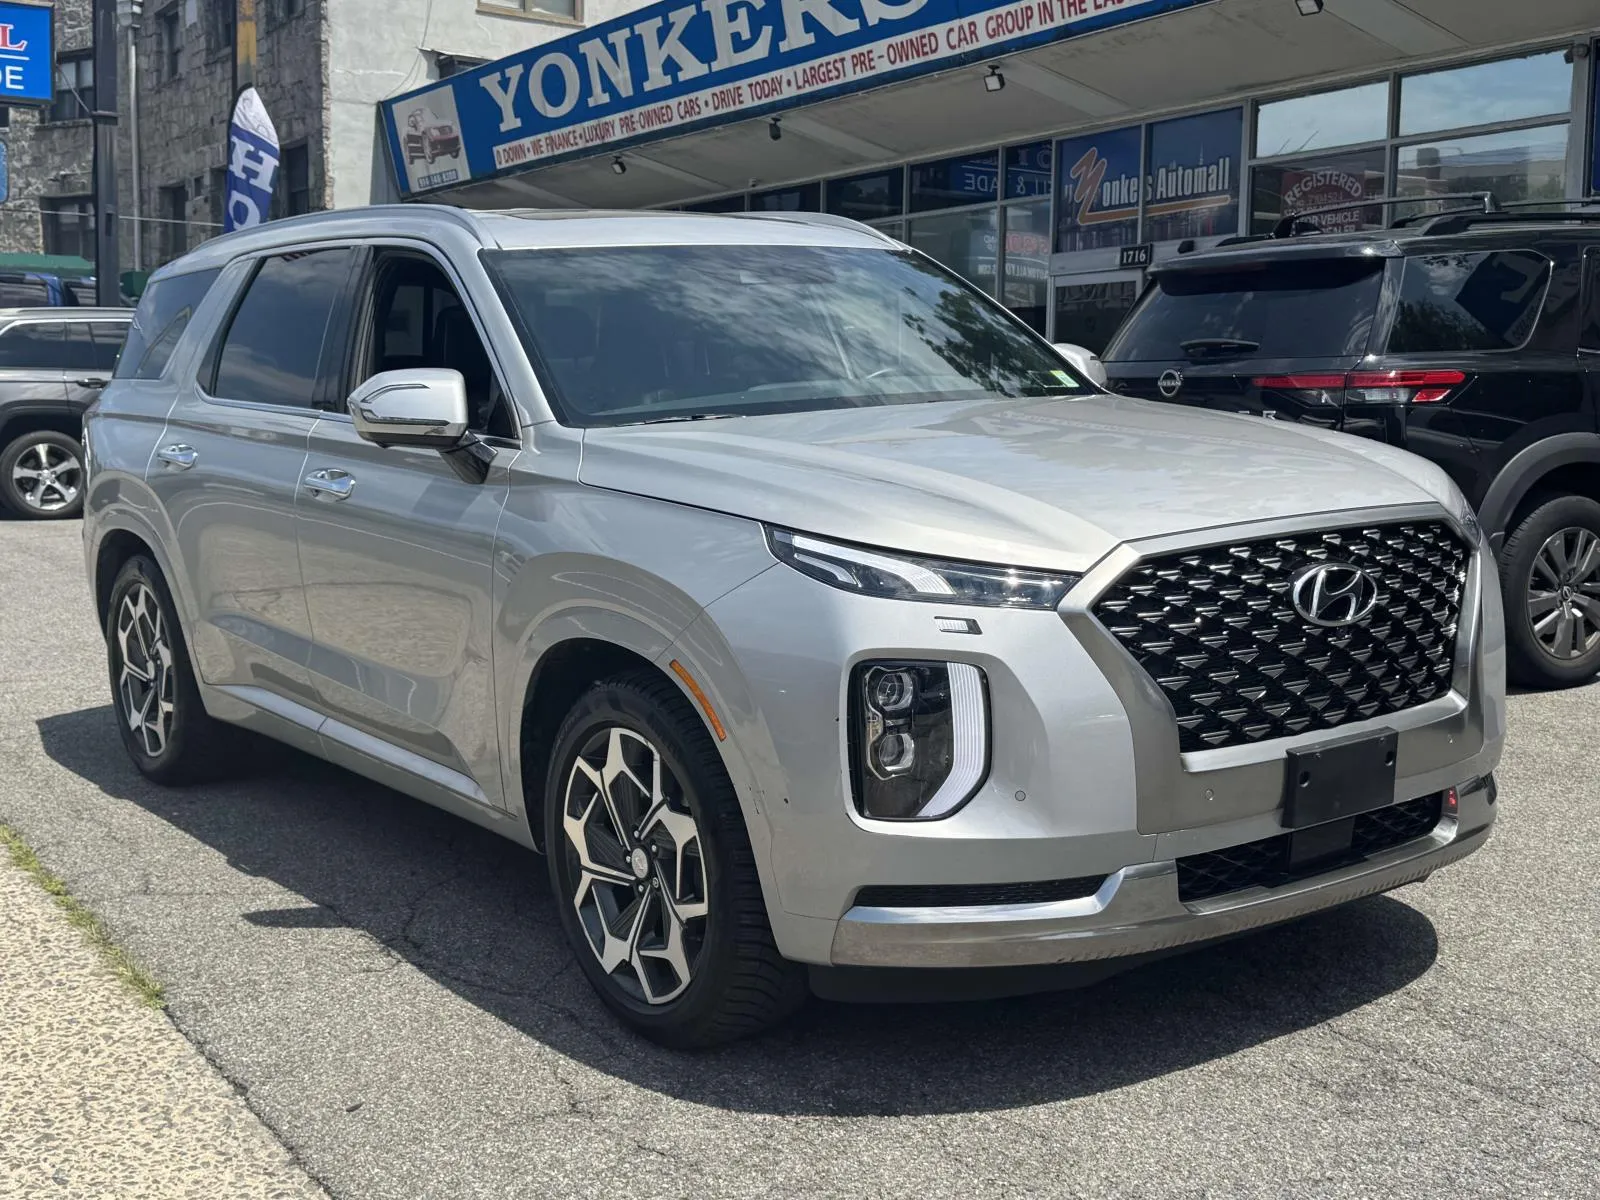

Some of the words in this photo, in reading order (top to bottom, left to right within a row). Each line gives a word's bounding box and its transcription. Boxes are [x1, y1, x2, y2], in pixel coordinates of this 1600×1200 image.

[0, 65, 24, 90] E
[503, 143, 527, 163] DOWN
[529, 137, 545, 156] WE
[545, 129, 579, 153] FINANCE
[583, 119, 616, 144] LUXURY
[619, 103, 674, 134] PRE-OWNED
[677, 96, 702, 120] CARS
[711, 86, 745, 111] DRIVE
[748, 74, 785, 103] TODAY
[794, 57, 847, 90] LARGEST
[945, 20, 980, 50] CAR
[985, 4, 1034, 40] GROUP
[1038, 0, 1055, 26] IN
[1059, 0, 1088, 19] THE
[1070, 146, 1153, 226] Yonkes
[1156, 156, 1231, 200] Automall
[1283, 170, 1363, 206] REGISTERED
[1321, 210, 1360, 225] VEHICLE
[1122, 249, 1147, 264] 1716
